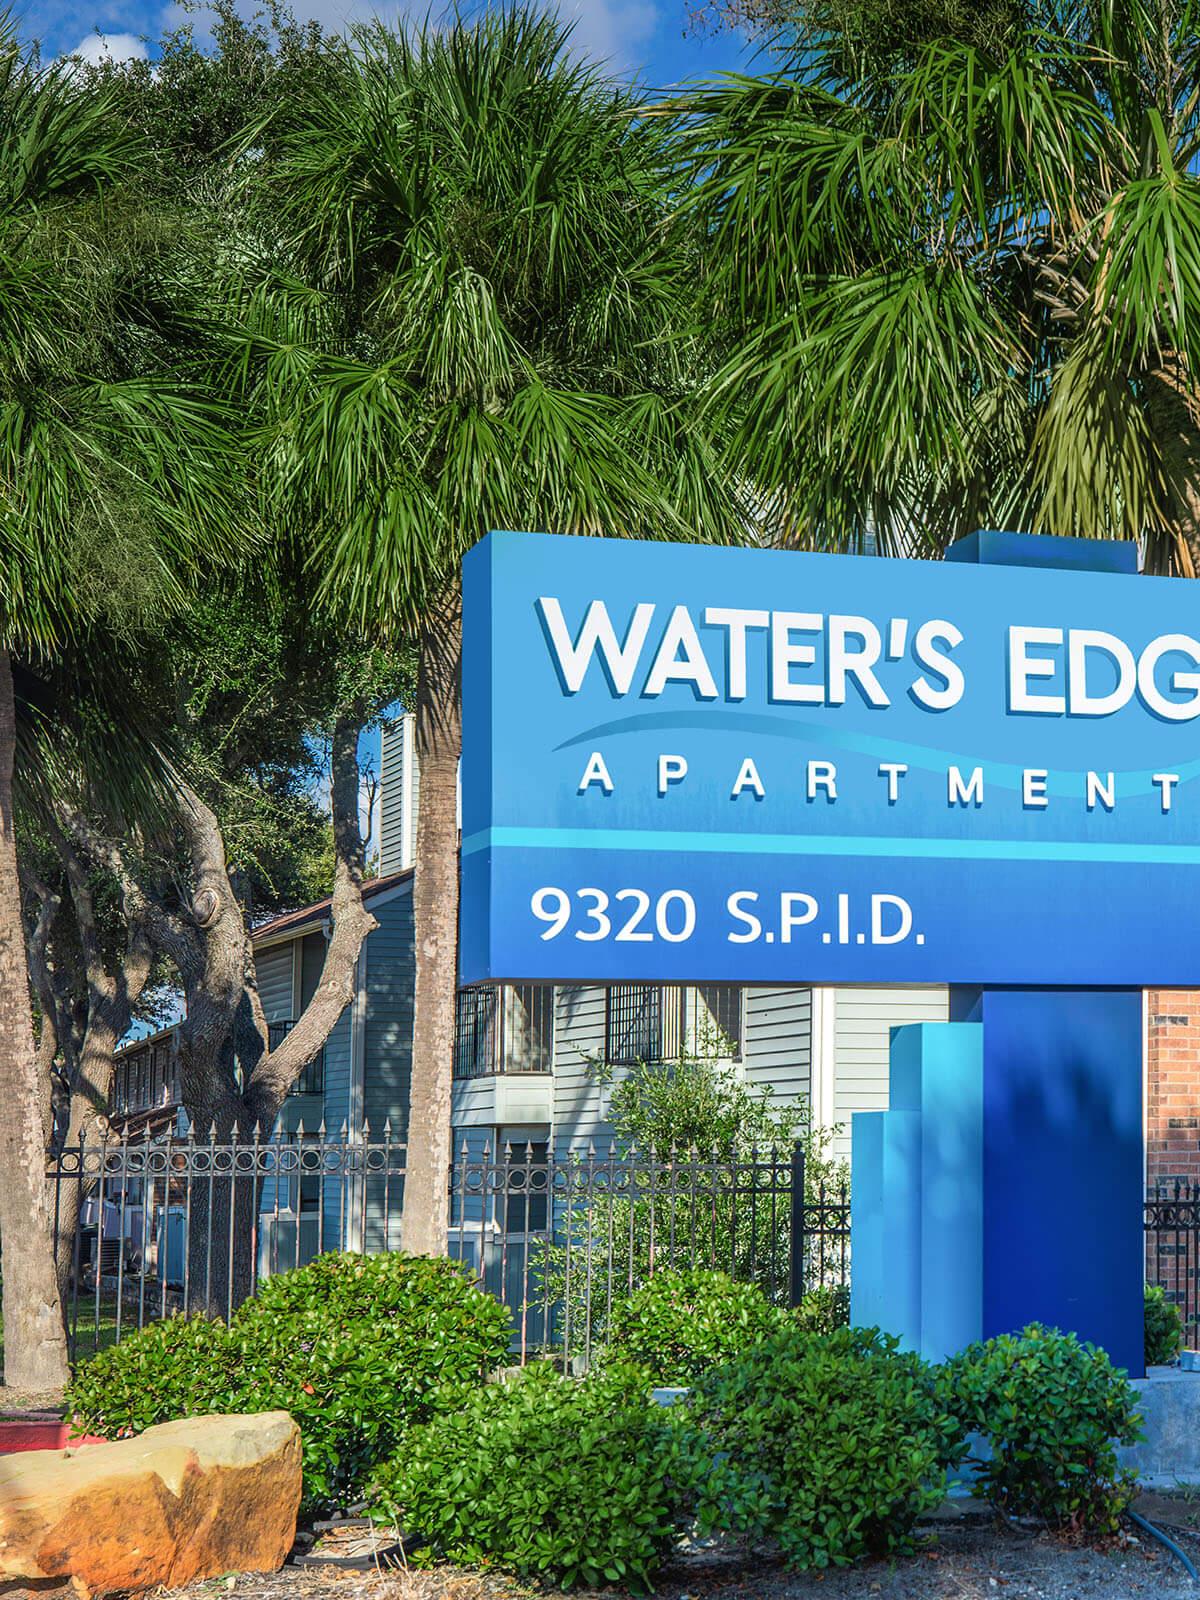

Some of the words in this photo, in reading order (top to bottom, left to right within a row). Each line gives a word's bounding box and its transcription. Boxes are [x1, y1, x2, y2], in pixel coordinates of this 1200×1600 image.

[535, 596, 967, 711] WATER'S
[530, 887, 696, 943] 9320
[726, 890, 926, 946] S.P.I.D.
